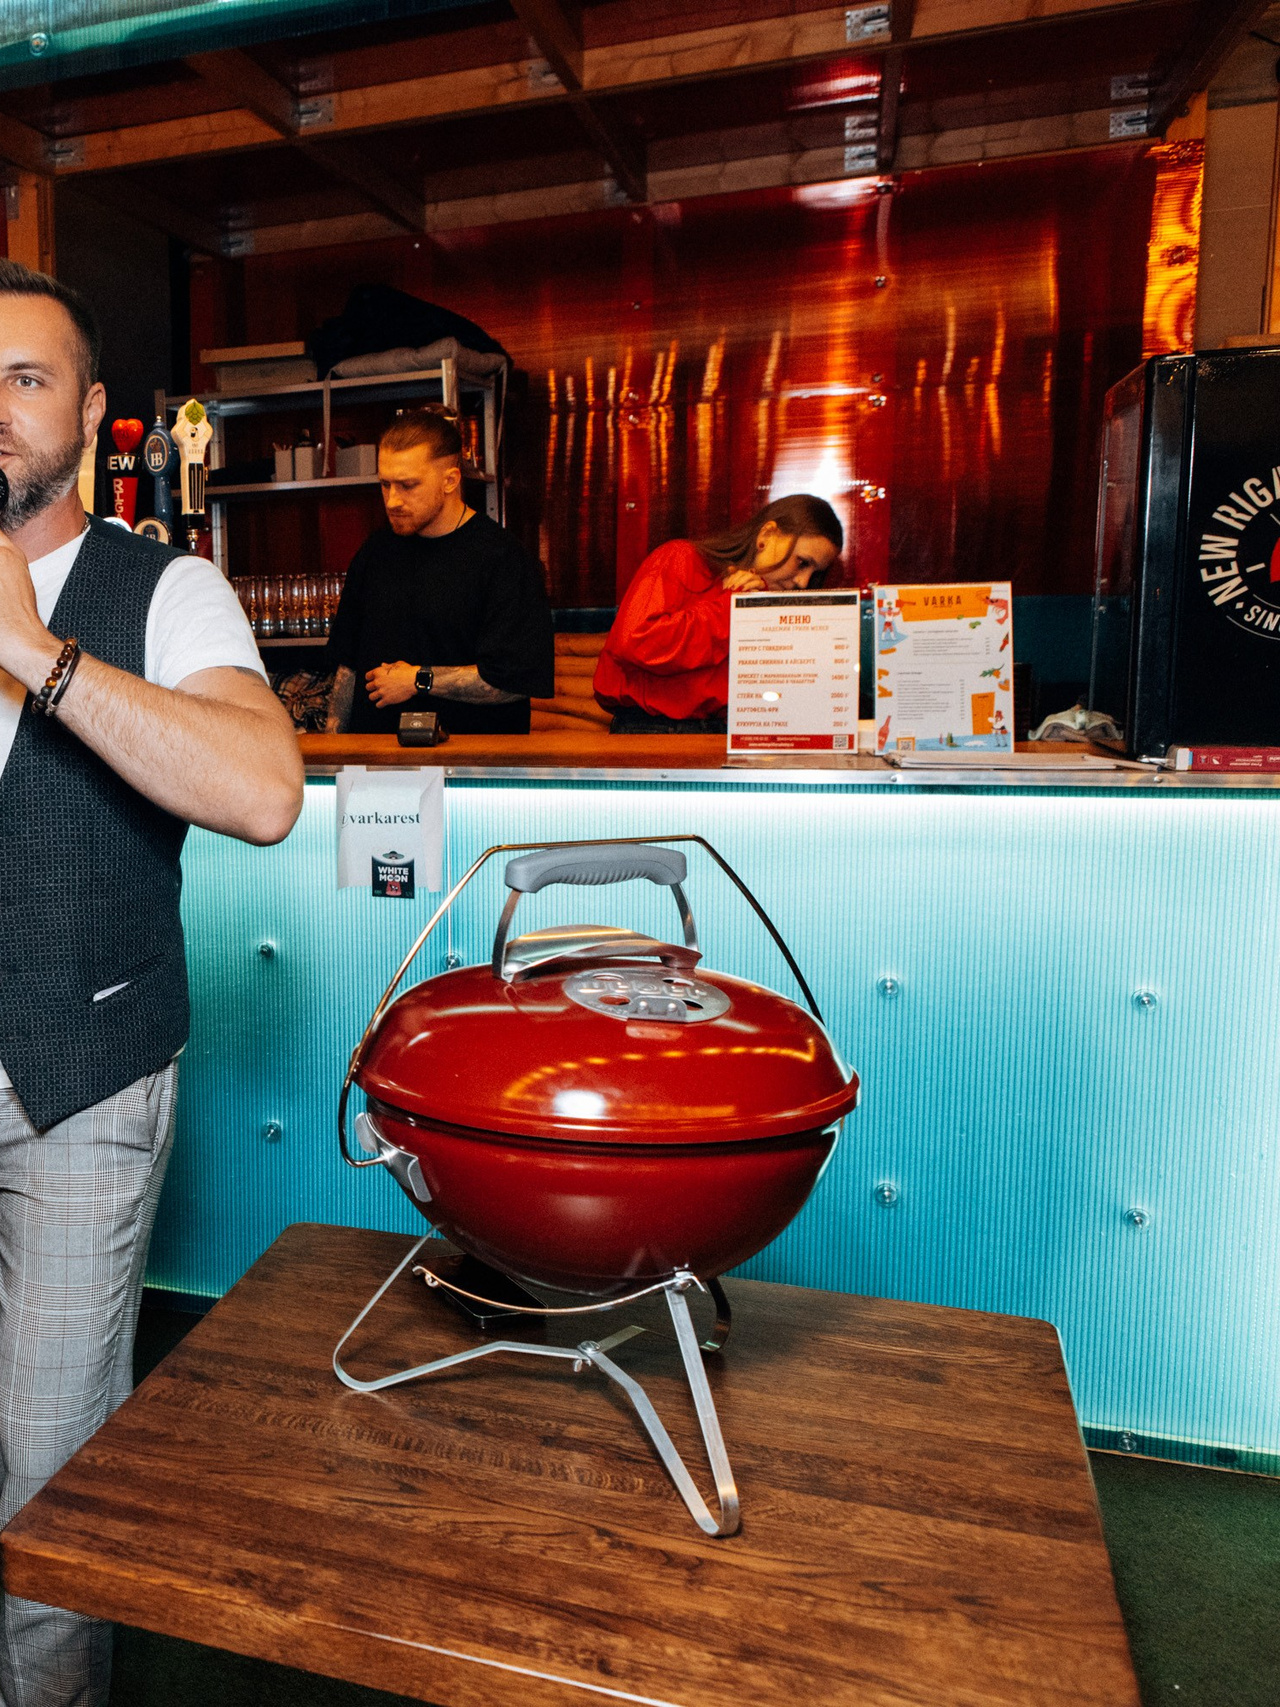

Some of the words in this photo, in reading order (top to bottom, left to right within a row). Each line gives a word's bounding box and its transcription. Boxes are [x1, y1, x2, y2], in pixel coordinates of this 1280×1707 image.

[107, 455, 136, 471] EW
[1198, 533, 1249, 607] NEW
[923, 595, 962, 606] VARKA
[779, 615, 811, 624] МЕНЮ
[1243, 604, 1280, 632] SIN
[377, 866, 409, 875] WHITE
[379, 873, 408, 883] MOON
